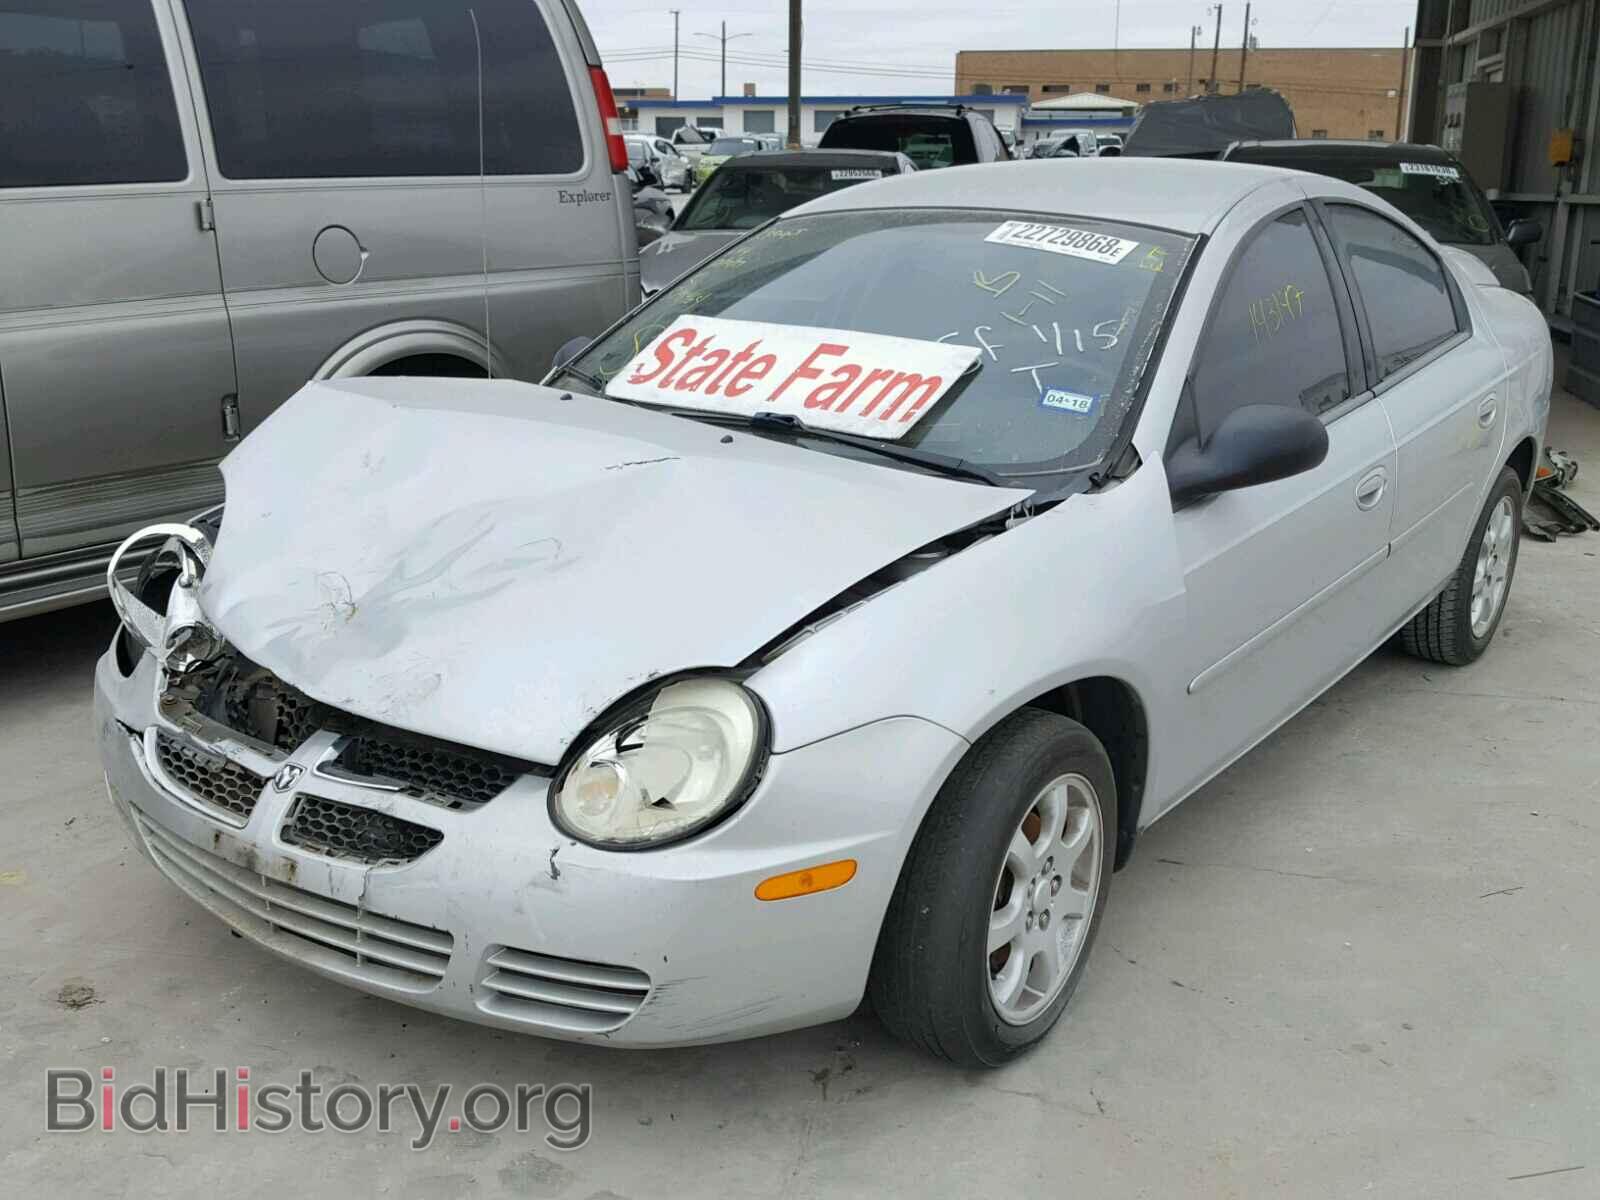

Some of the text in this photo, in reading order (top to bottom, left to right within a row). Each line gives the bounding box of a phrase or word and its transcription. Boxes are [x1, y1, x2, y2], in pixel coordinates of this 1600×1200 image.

[557, 189, 611, 206] Explorer
[626, 328, 943, 422] State Farm
